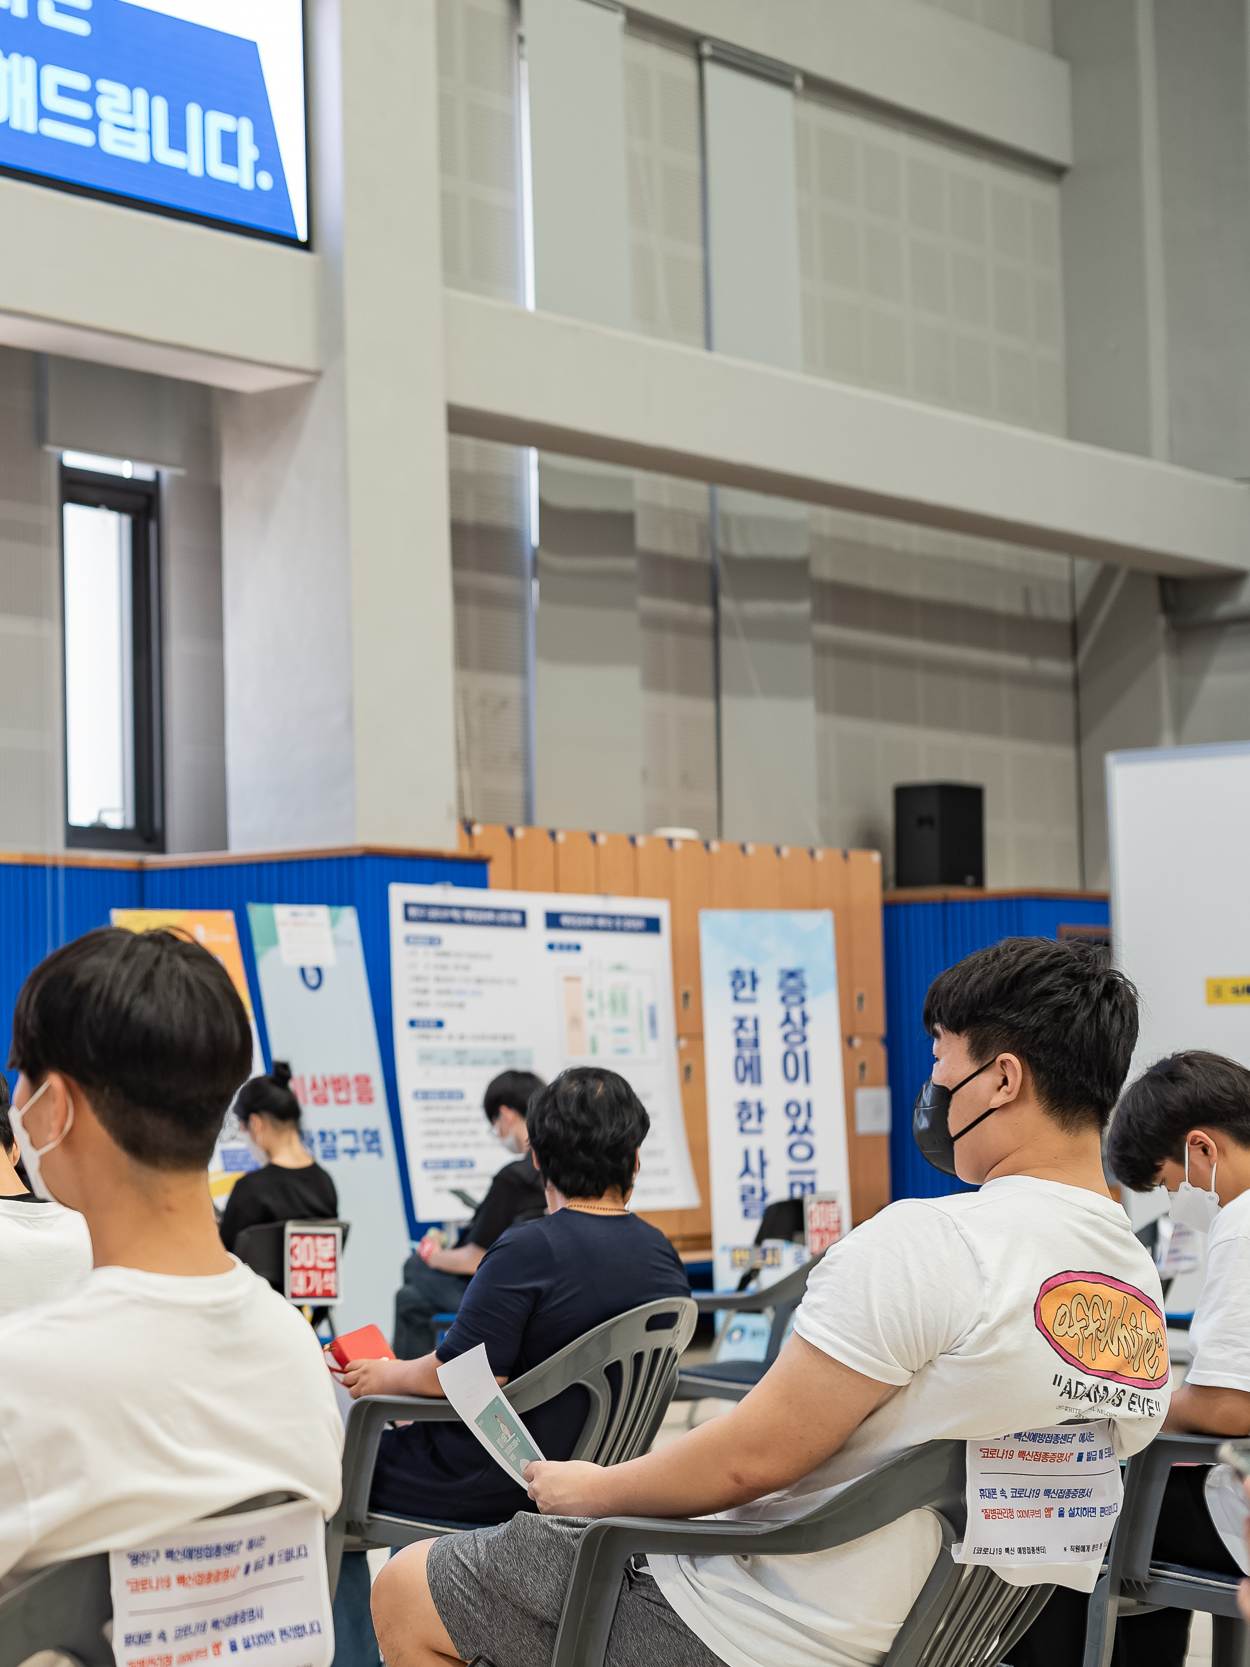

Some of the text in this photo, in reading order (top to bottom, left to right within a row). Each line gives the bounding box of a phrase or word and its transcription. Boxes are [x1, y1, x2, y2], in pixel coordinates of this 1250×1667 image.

[778, 968, 810, 1085] 증상이
[729, 968, 768, 1219] 한 집에 한 사람
[291, 1235, 336, 1268] 30분
[979, 1448, 1014, 1460] "코로나19
[1018, 1449, 1074, 1464] 백신접종증명서"
[979, 1488, 998, 1500] 휴대폰
[1010, 1488, 1041, 1499] 코로나19
[1043, 1488, 1093, 1499] 백신접종증명서
[981, 1507, 1015, 1520] "질병관리청
[1057, 1506, 1065, 1518] 을
[1068, 1506, 1096, 1518] 설치하면
